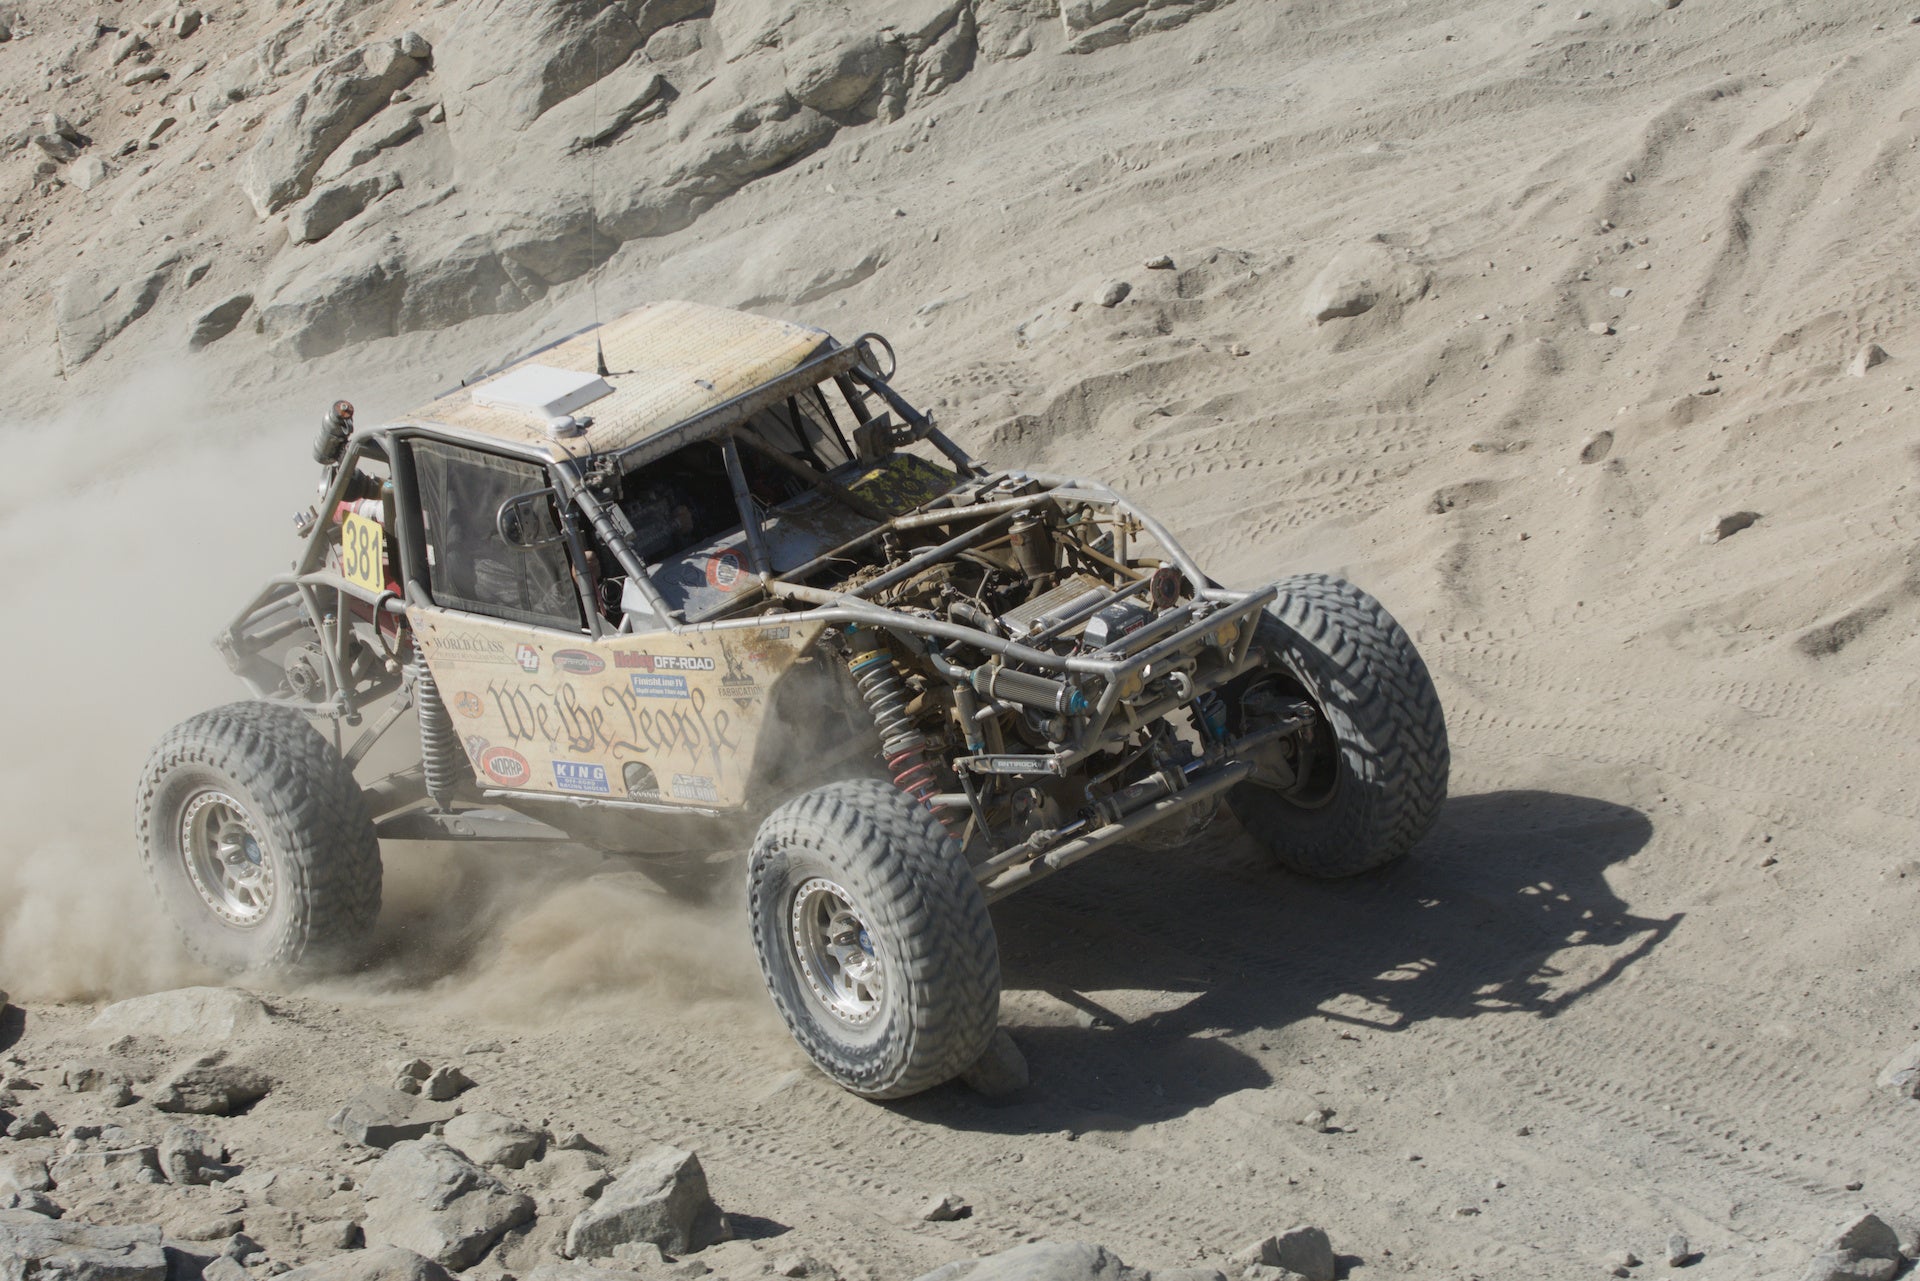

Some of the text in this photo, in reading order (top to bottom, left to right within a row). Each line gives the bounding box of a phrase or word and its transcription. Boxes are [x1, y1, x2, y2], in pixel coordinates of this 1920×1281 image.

[346, 519, 380, 588] 381
[433, 637, 505, 653] WORLD CLASS
[613, 650, 715, 674] Holley OFF-ROAD
[633, 676, 684, 687] FinishLine IV
[717, 685, 763, 698] FABRICATION
[486, 678, 561, 748] We
[553, 681, 614, 754] the
[602, 684, 742, 779] People
[490, 757, 523, 776] NORRA
[556, 763, 604, 780] KING
[672, 774, 715, 788] APEX
